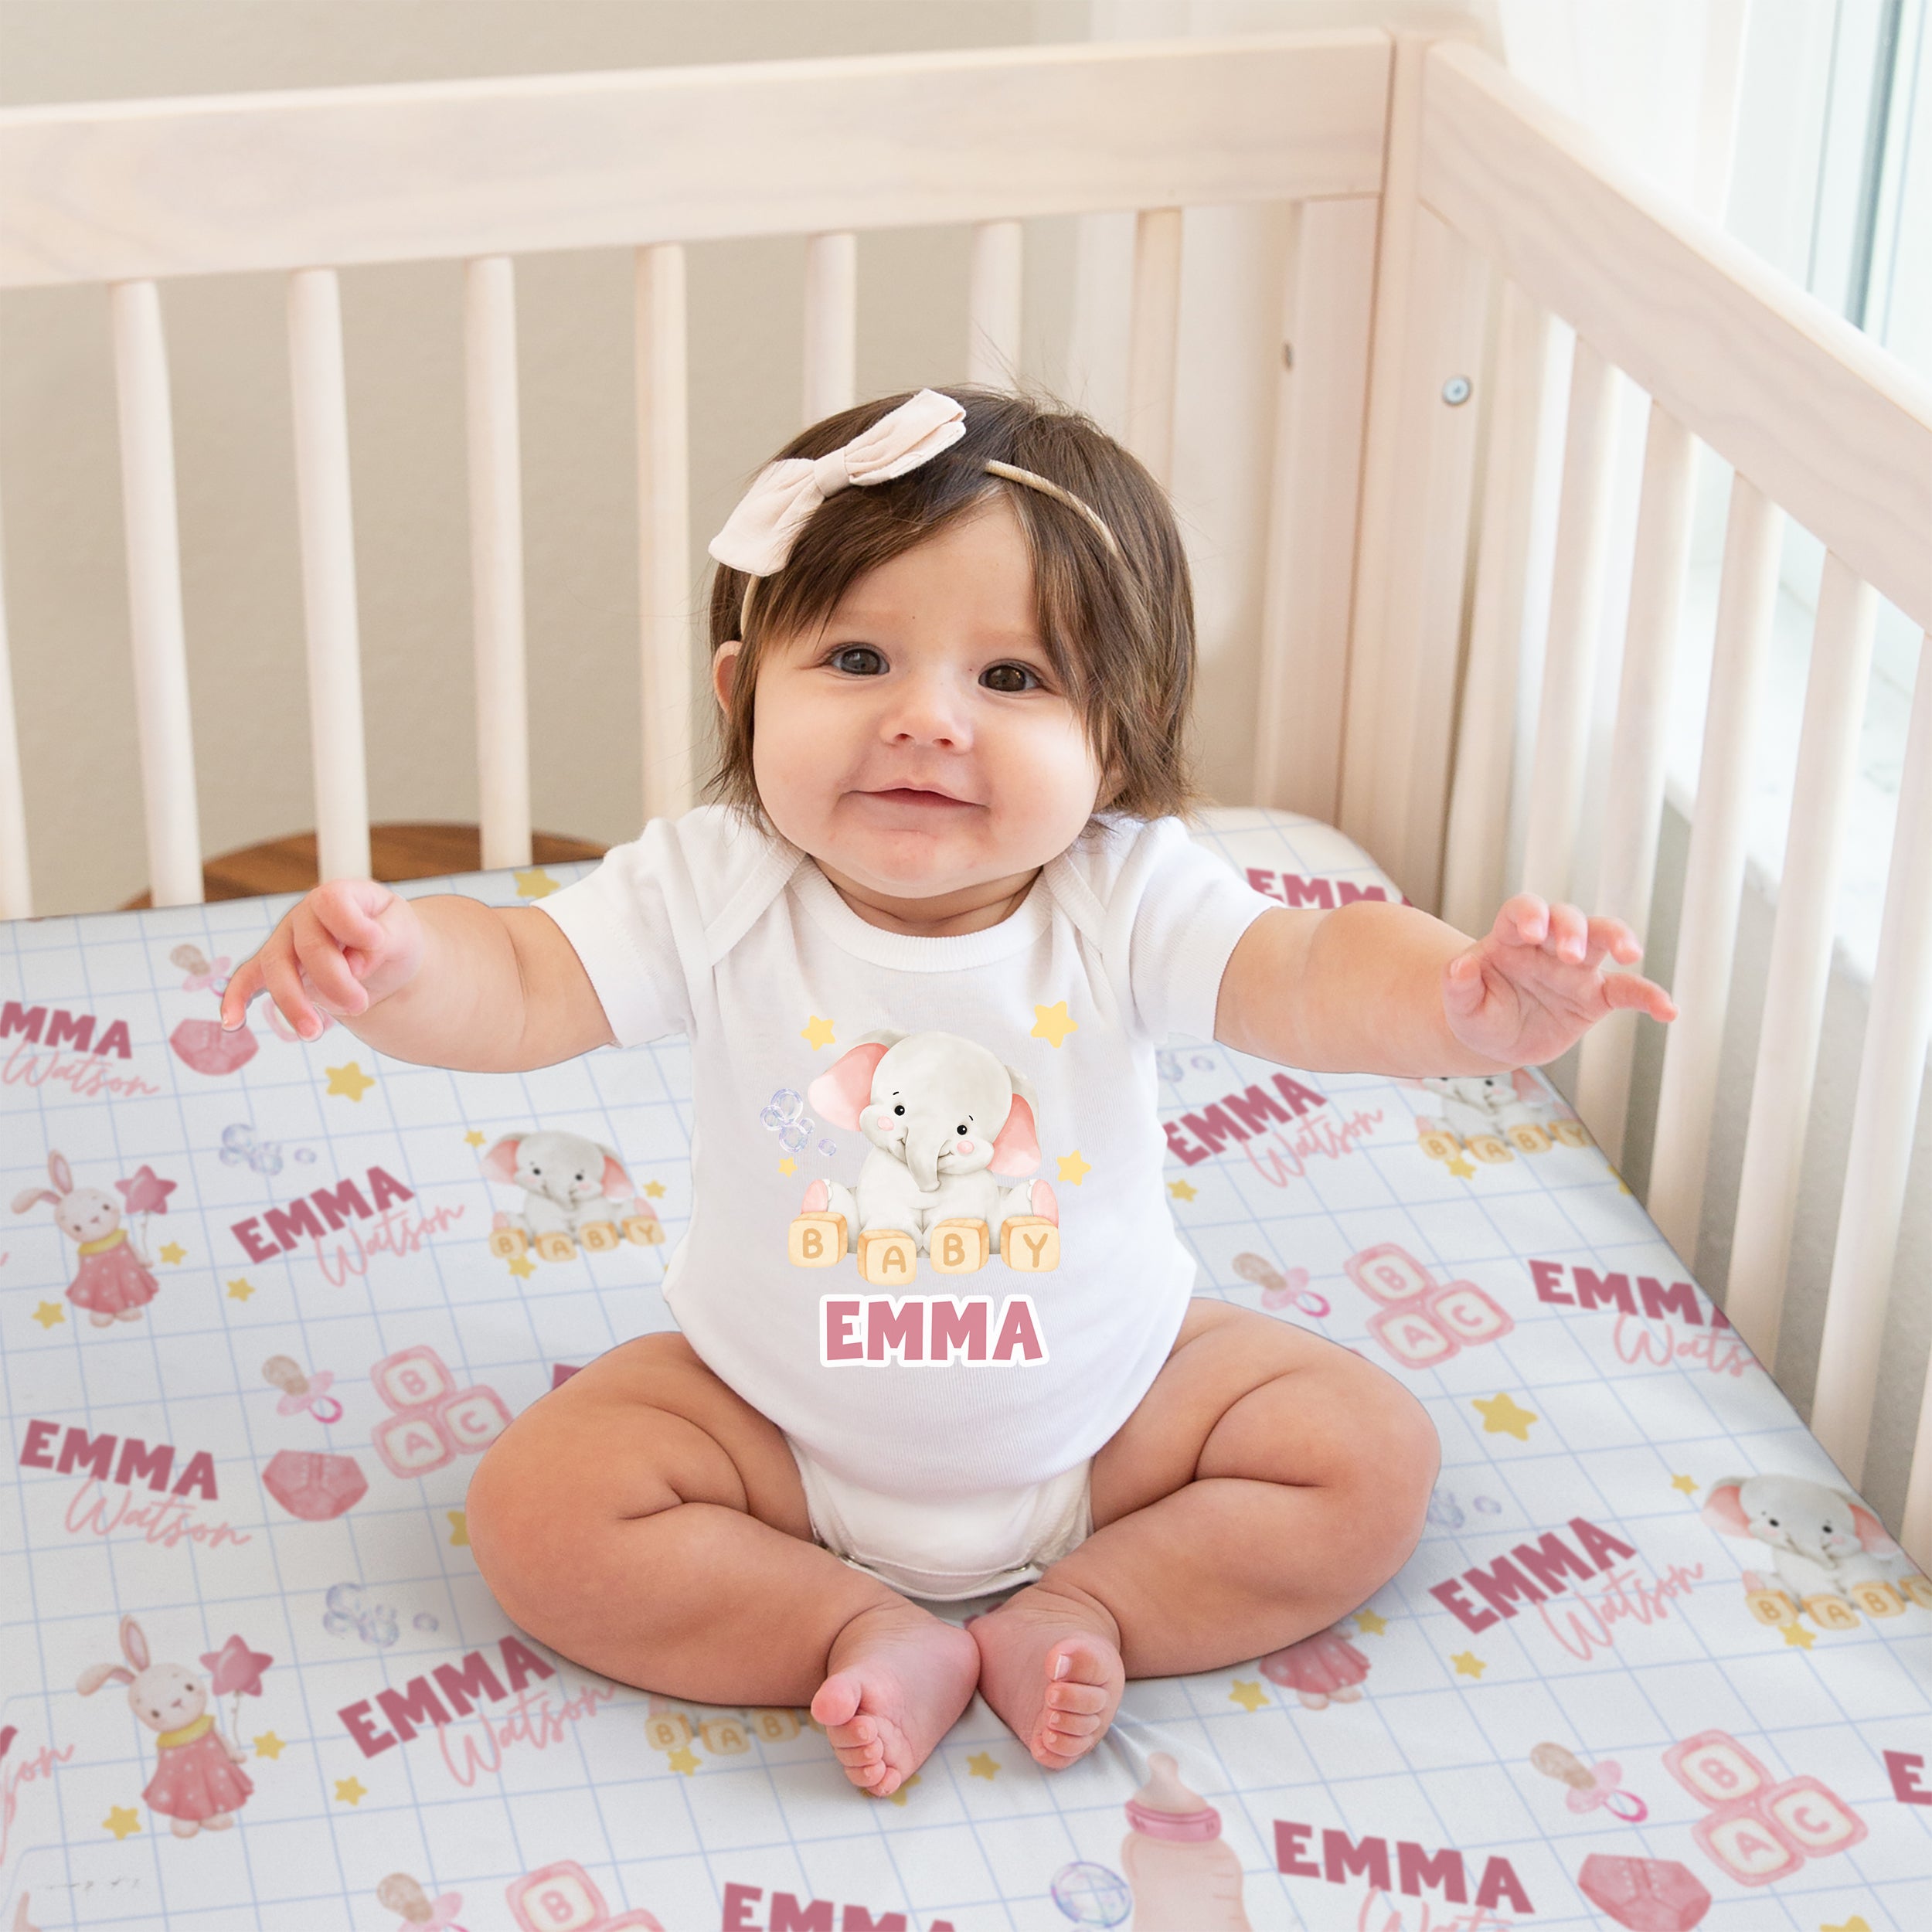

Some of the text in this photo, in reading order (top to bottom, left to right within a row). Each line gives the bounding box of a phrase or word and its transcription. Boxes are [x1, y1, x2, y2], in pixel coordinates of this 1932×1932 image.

[1246, 867, 1413, 910] EMM
[2, 1040, 160, 1097] Watson
[1162, 1072, 1328, 1167] EMMA
[1240, 1108, 1384, 1188] Watson
[230, 1165, 416, 1265] EMMA
[315, 1204, 465, 1287] Watson
[802, 1227, 1049, 1274] BABY
[825, 1300, 1043, 1361] EMMA
[19, 1419, 218, 1501] EMMA
[65, 1475, 253, 1549] Watson
[1428, 1517, 1637, 1634] EMMA
[1535, 1562, 1704, 1662] Watson
[1757, 1586, 1932, 1622] BAB
[337, 1635, 556, 1759] EMMA
[437, 1685, 616, 1787] Watson
[1273, 1819, 1536, 1914] EMMA
